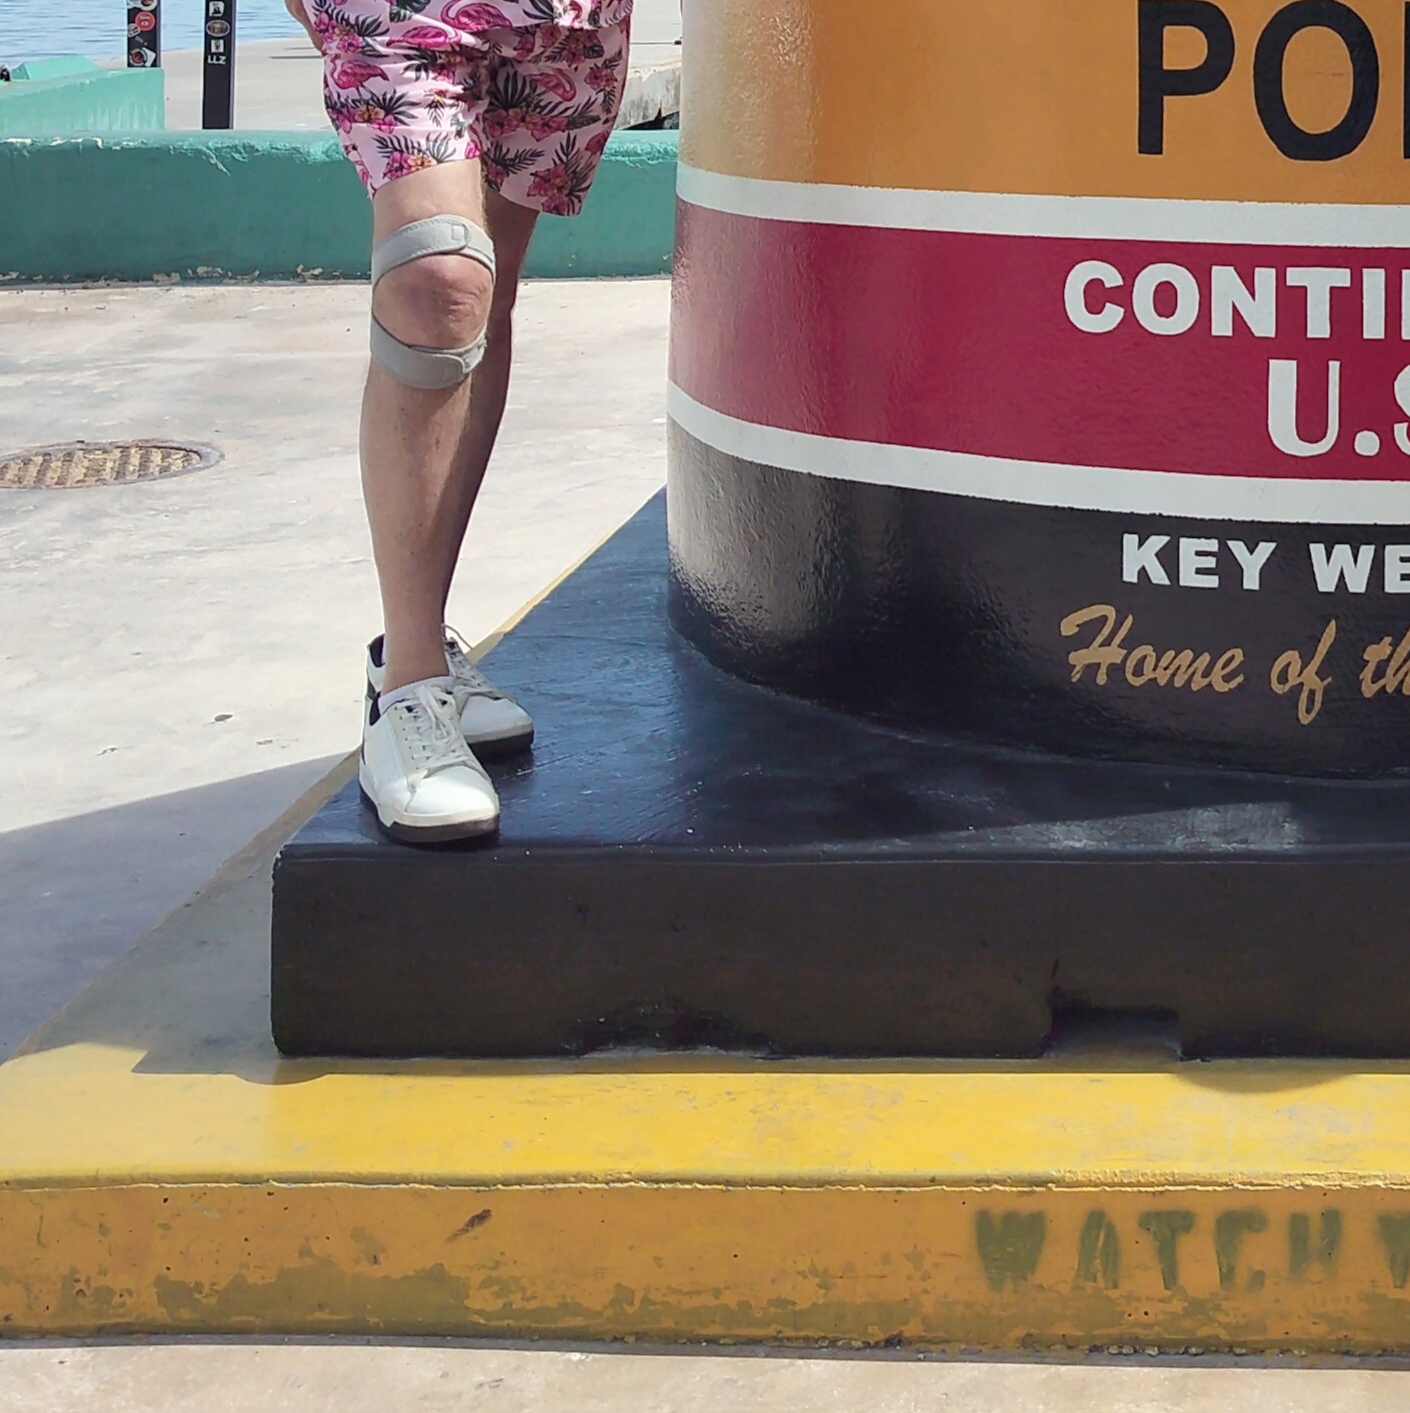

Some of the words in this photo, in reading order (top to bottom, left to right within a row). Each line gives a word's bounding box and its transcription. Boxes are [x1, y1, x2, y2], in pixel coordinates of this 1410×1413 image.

[1122, 533, 1277, 590] KEY
[1059, 604, 1245, 694] Home
[1270, 621, 1337, 725] of
[974, 1207, 1343, 1292] WATCH
